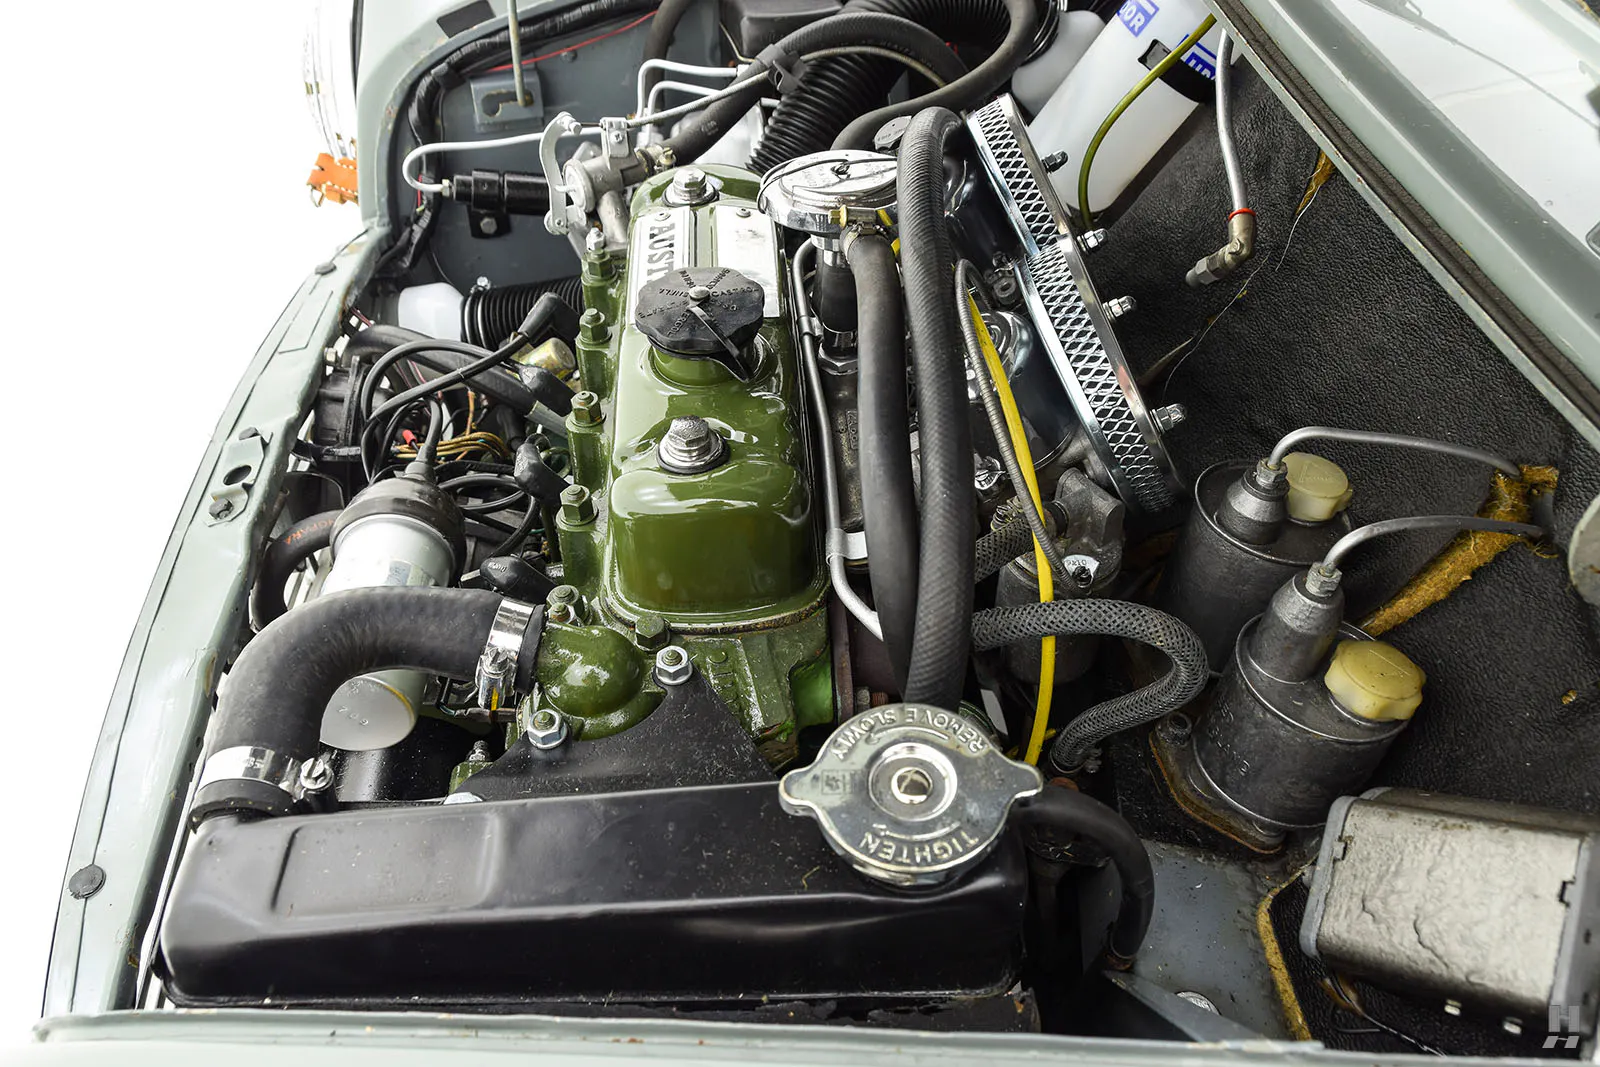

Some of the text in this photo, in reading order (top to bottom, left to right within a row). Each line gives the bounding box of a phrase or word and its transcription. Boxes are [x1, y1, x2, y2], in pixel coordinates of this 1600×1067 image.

[647, 222, 675, 281] AUST
[831, 707, 988, 760] REMOVE SLOWLY
[859, 830, 980, 864] TIGHTEN
